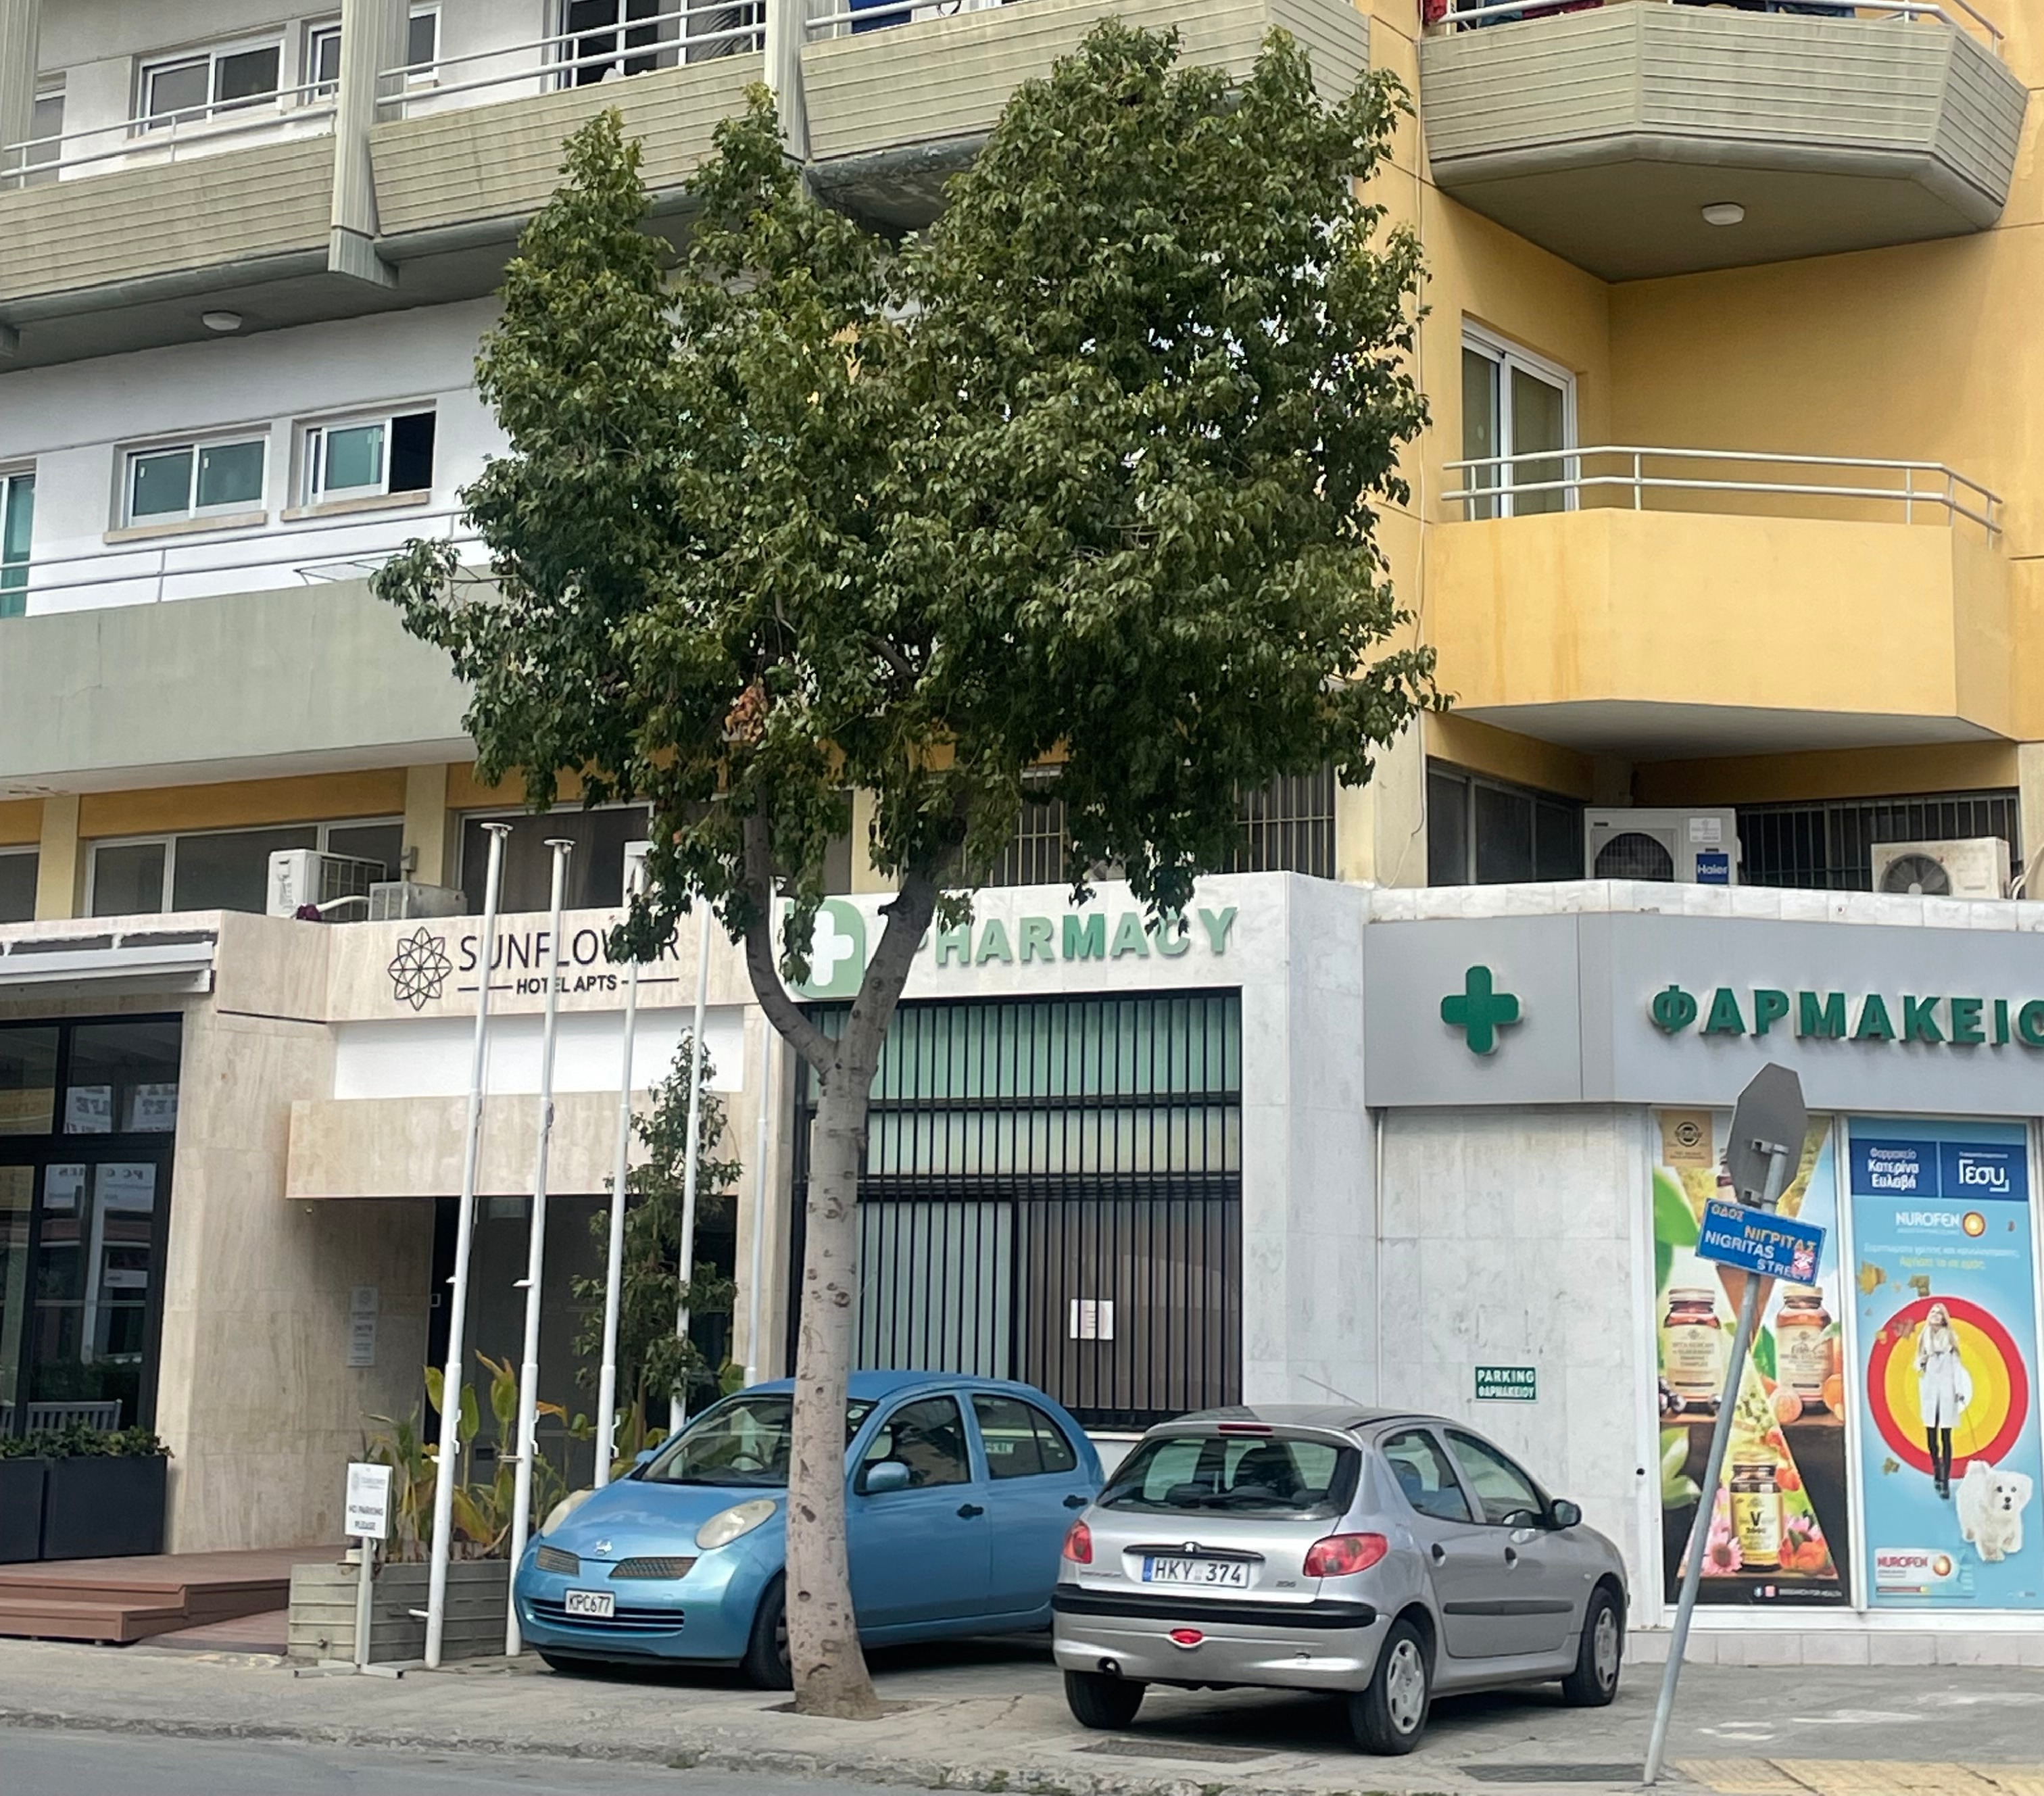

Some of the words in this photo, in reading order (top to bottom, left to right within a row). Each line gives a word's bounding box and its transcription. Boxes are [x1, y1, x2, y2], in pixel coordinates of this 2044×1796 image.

[1697, 865, 1728, 874] Haier
[918, 906, 1238, 967] HARMACY
[459, 928, 679, 971] SUNFLOR
[573, 975, 617, 992] APTS
[1868, 1159, 1920, 1175] Κατερίνα
[1711, 1204, 1745, 1223] ΟΔΟΣ
[1895, 1211, 1960, 1228] NUROFEN
[1705, 1230, 1775, 1259] NIGRITAS
[1757, 1257, 1811, 1280] STRE
[1478, 1369, 1534, 1383] PARKING
[1155, 1559, 1194, 1580] HKY
[1206, 1563, 1241, 1583] 374
[1877, 1556, 1928, 1568] NUROFEN
[568, 1595, 611, 1613] KPC677
